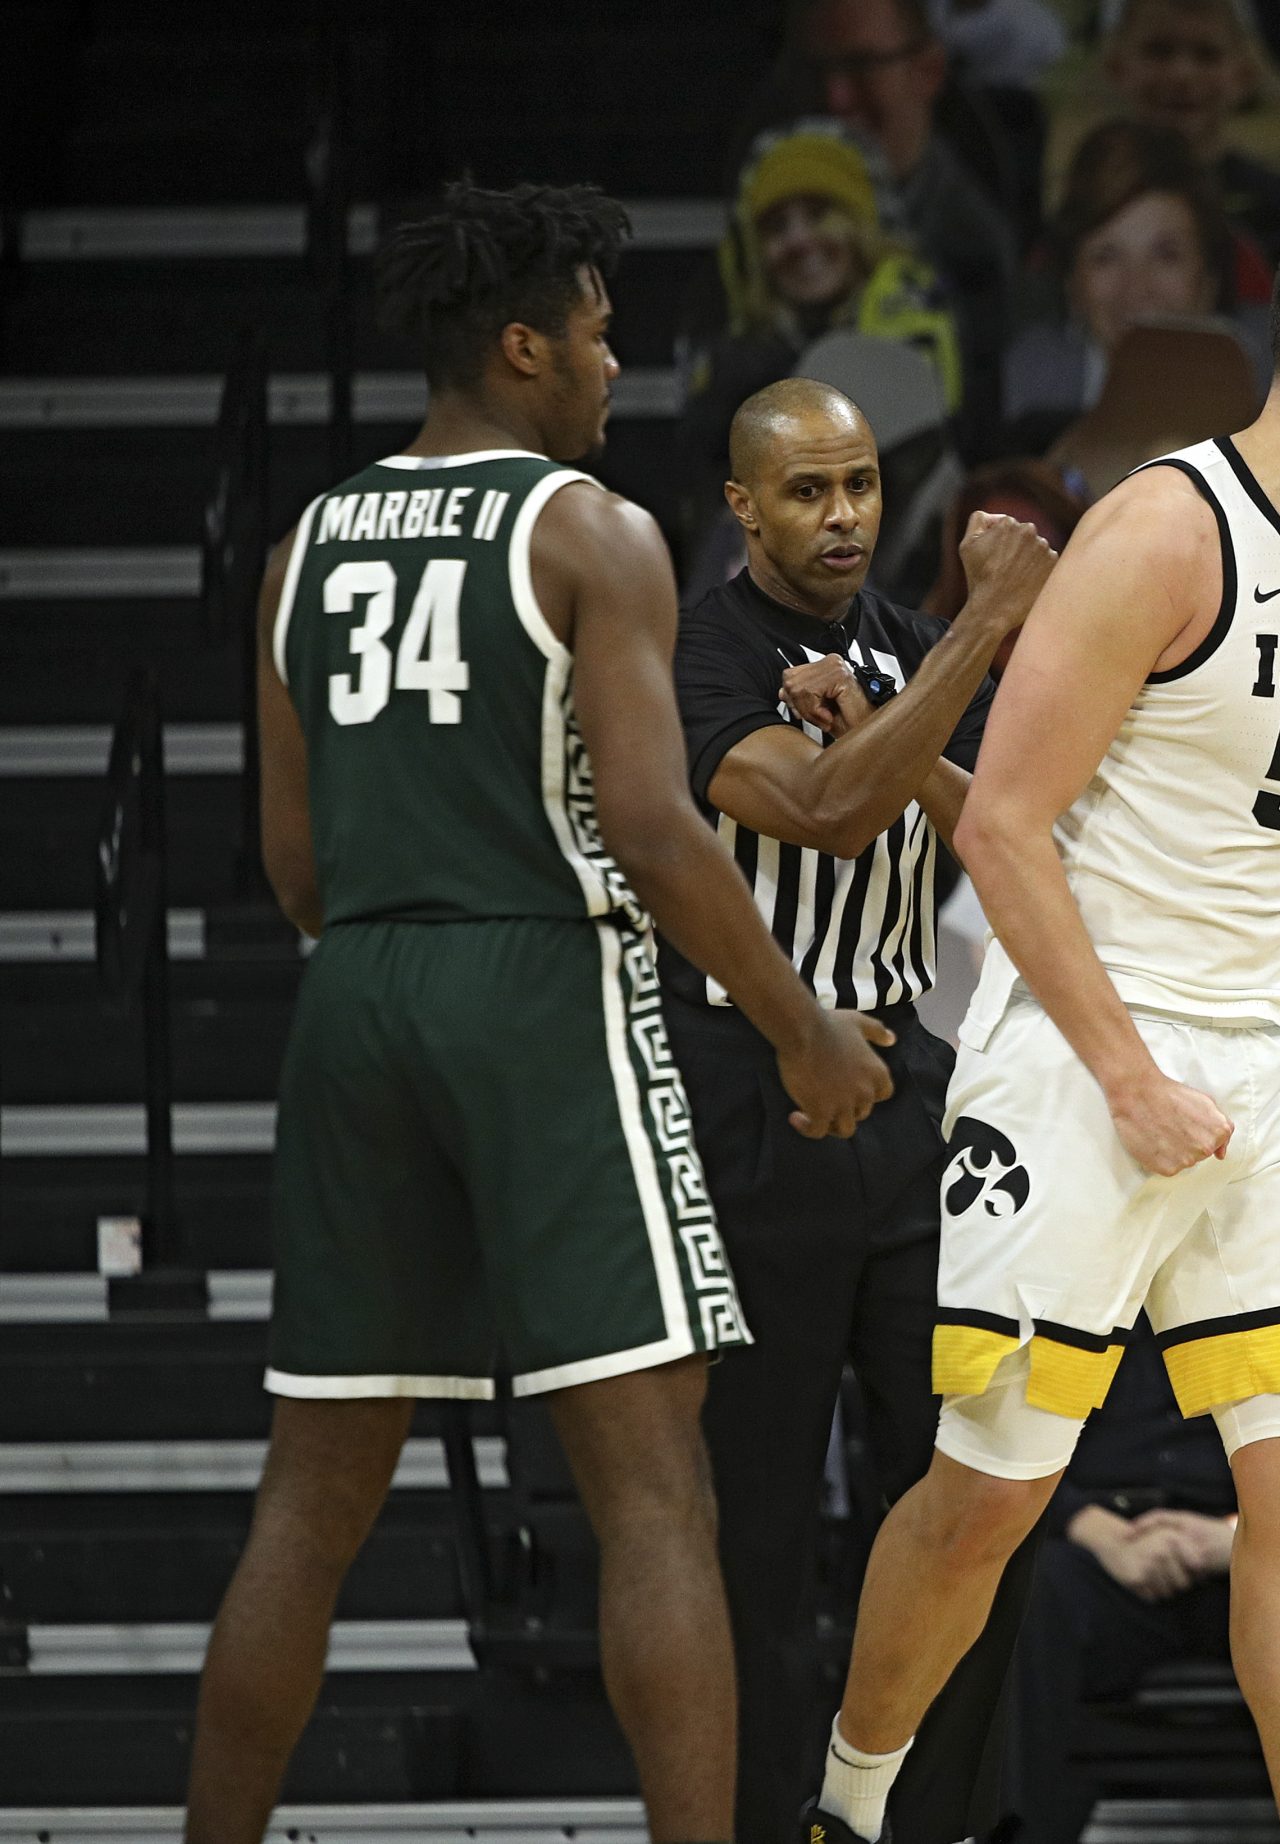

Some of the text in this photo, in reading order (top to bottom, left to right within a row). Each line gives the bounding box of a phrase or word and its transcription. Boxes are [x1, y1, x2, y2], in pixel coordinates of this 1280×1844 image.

[315, 486, 511, 545] MARBLE II
[323, 559, 470, 726] 34
